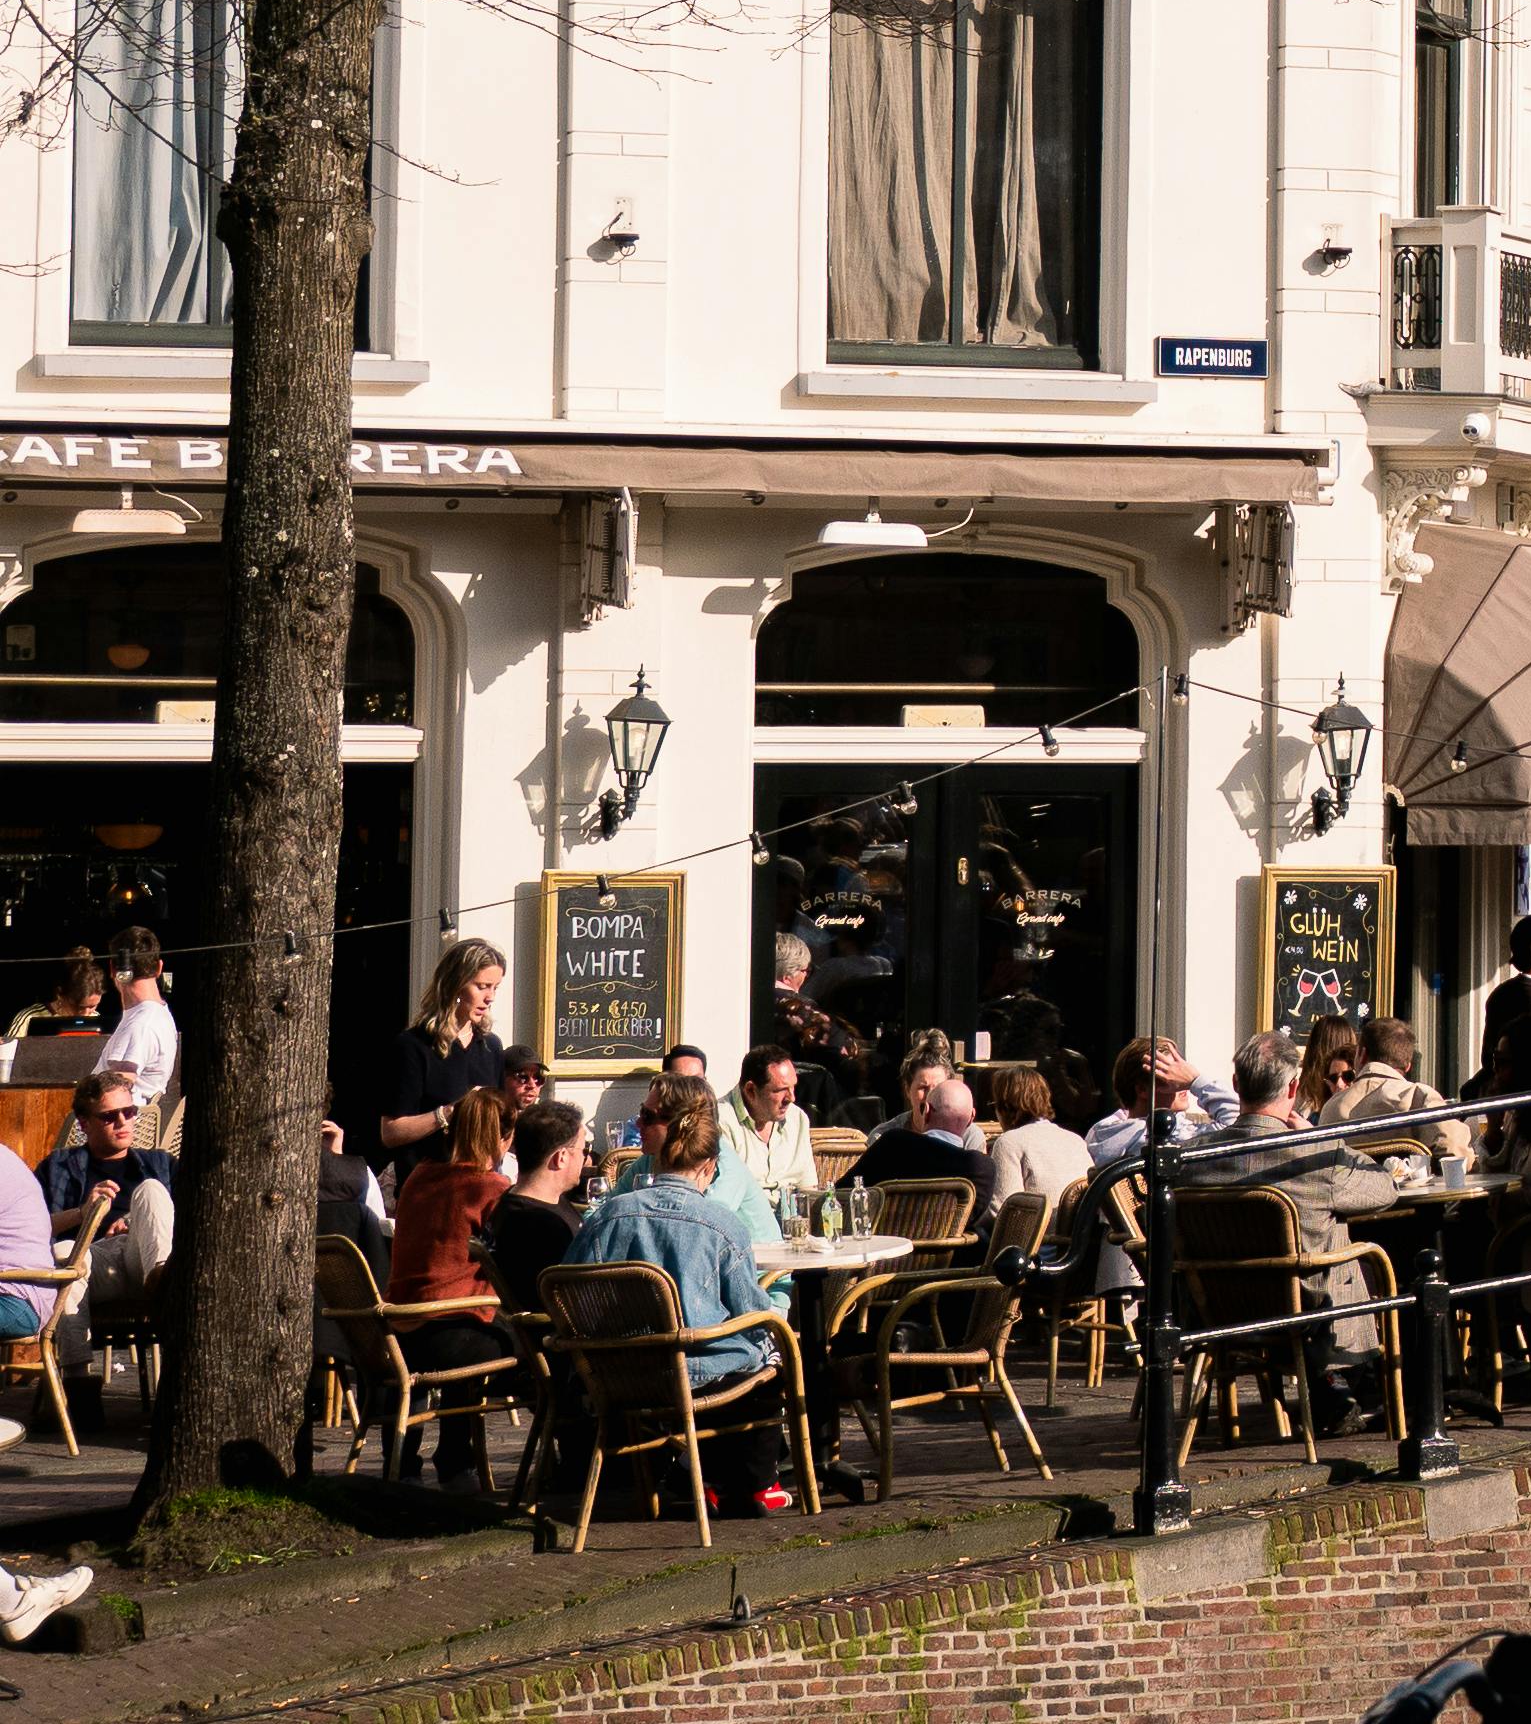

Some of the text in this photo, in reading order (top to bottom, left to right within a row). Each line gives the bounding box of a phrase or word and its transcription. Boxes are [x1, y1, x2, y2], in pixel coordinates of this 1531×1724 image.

[1175, 347, 1252, 368] RAPENBURG
[0, 436, 522, 474] AFE BRERA
[801, 891, 882, 911] BARRERA
[1001, 889, 1082, 909] BARRERA
[571, 915, 645, 939] BOMPA
[1290, 907, 1341, 937] GLÜH
[1312, 936, 1359, 963] WEIN
[566, 948, 646, 978] WHITE
[558, 1018, 589, 1037] BOEM
[591, 1017, 630, 1038] LEKKER
